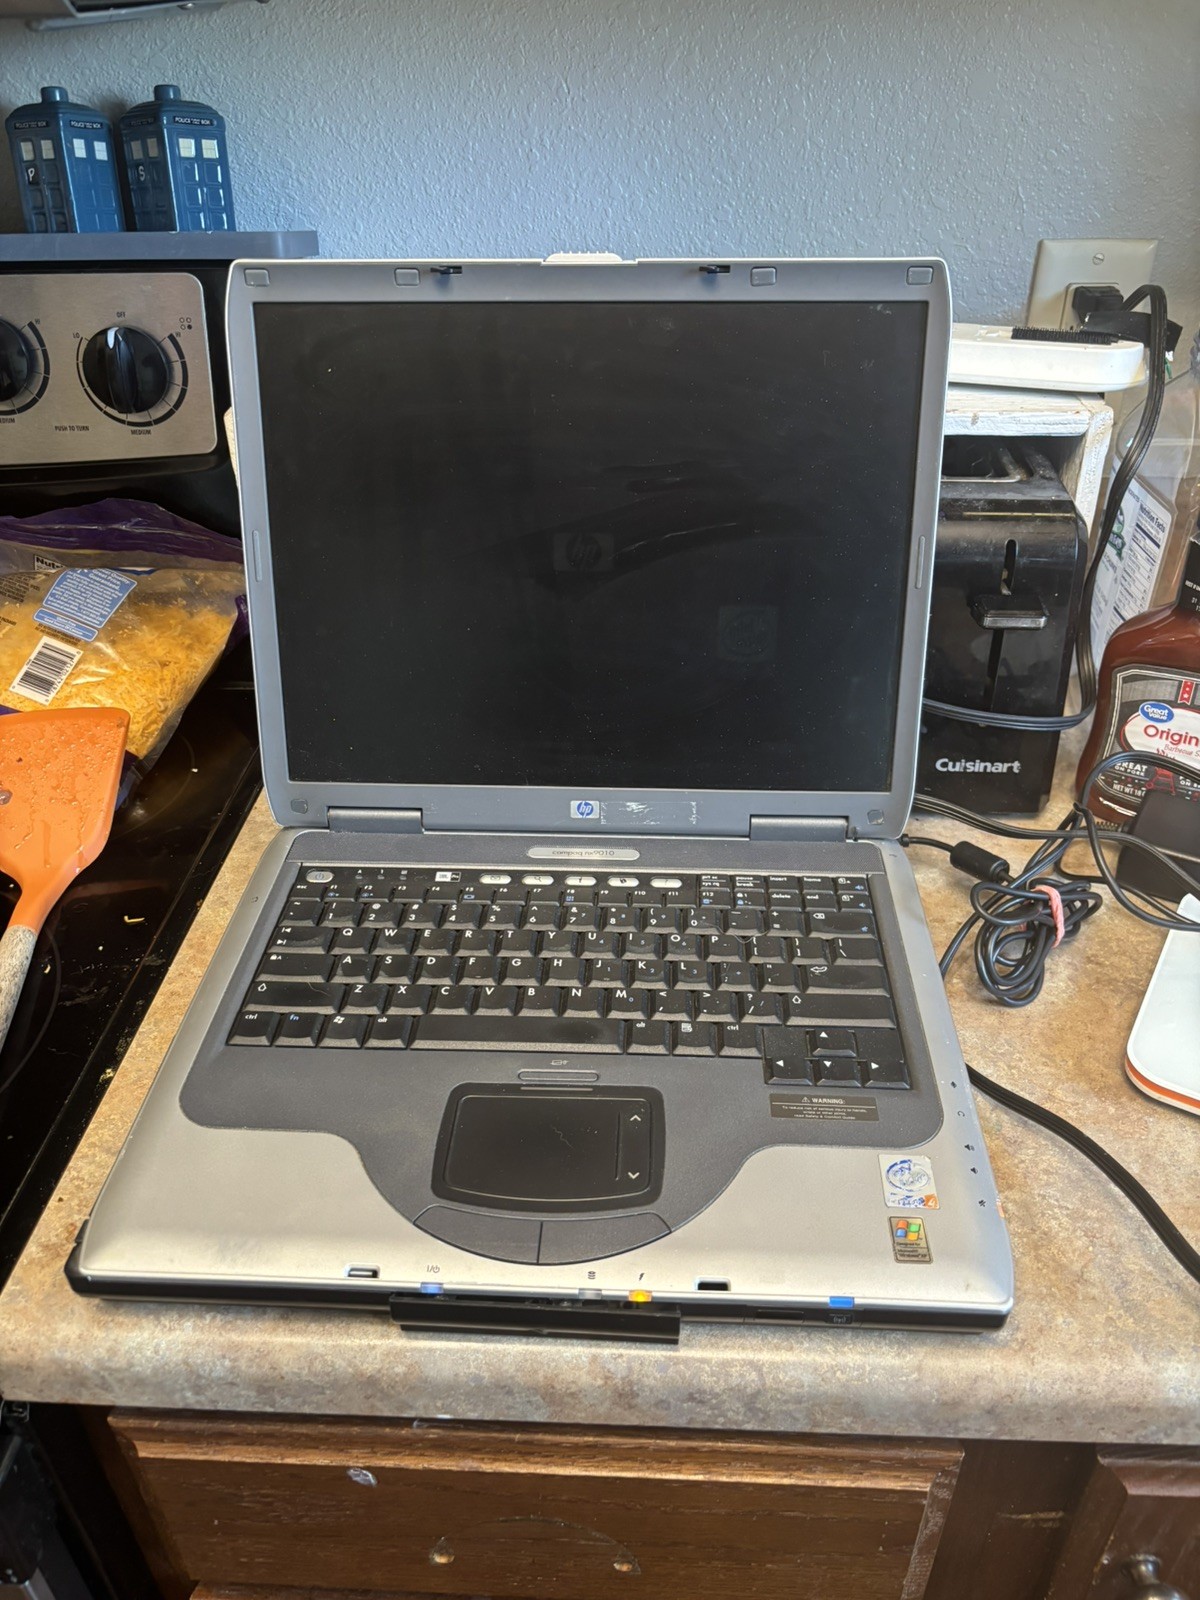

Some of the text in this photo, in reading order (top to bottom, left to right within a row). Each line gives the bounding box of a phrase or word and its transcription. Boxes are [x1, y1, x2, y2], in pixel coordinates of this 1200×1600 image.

[28, 168, 35, 181] P
[138, 165, 146, 181] S
[1144, 704, 1169, 716] Great
[935, 758, 1021, 773] Cuisinart
[1112, 784, 1124, 792] NET
[578, 801, 594, 818] hp
[342, 928, 354, 937] Q
[384, 928, 398, 937] W
[423, 929, 431, 937] E
[464, 930, 473, 938] R
[547, 931, 556, 940] Y
[588, 932, 597, 940] U
[670, 934, 681, 943] O
[711, 935, 719, 943] P
[342, 956, 352, 964] A
[385, 956, 393, 965] S
[427, 957, 436, 965] D
[469, 957, 476, 965] F
[511, 958, 522, 967] G
[553, 959, 563, 967] H
[596, 960, 602, 968] J
[638, 961, 647, 969] K
[681, 962, 687, 970] L
[354, 985, 363, 993] Z
[398, 985, 407, 994] X
[441, 986, 449, 995] C
[485, 987, 495, 996] V
[527, 988, 536, 996] B
[571, 989, 582, 997] N
[615, 990, 627, 998] M
